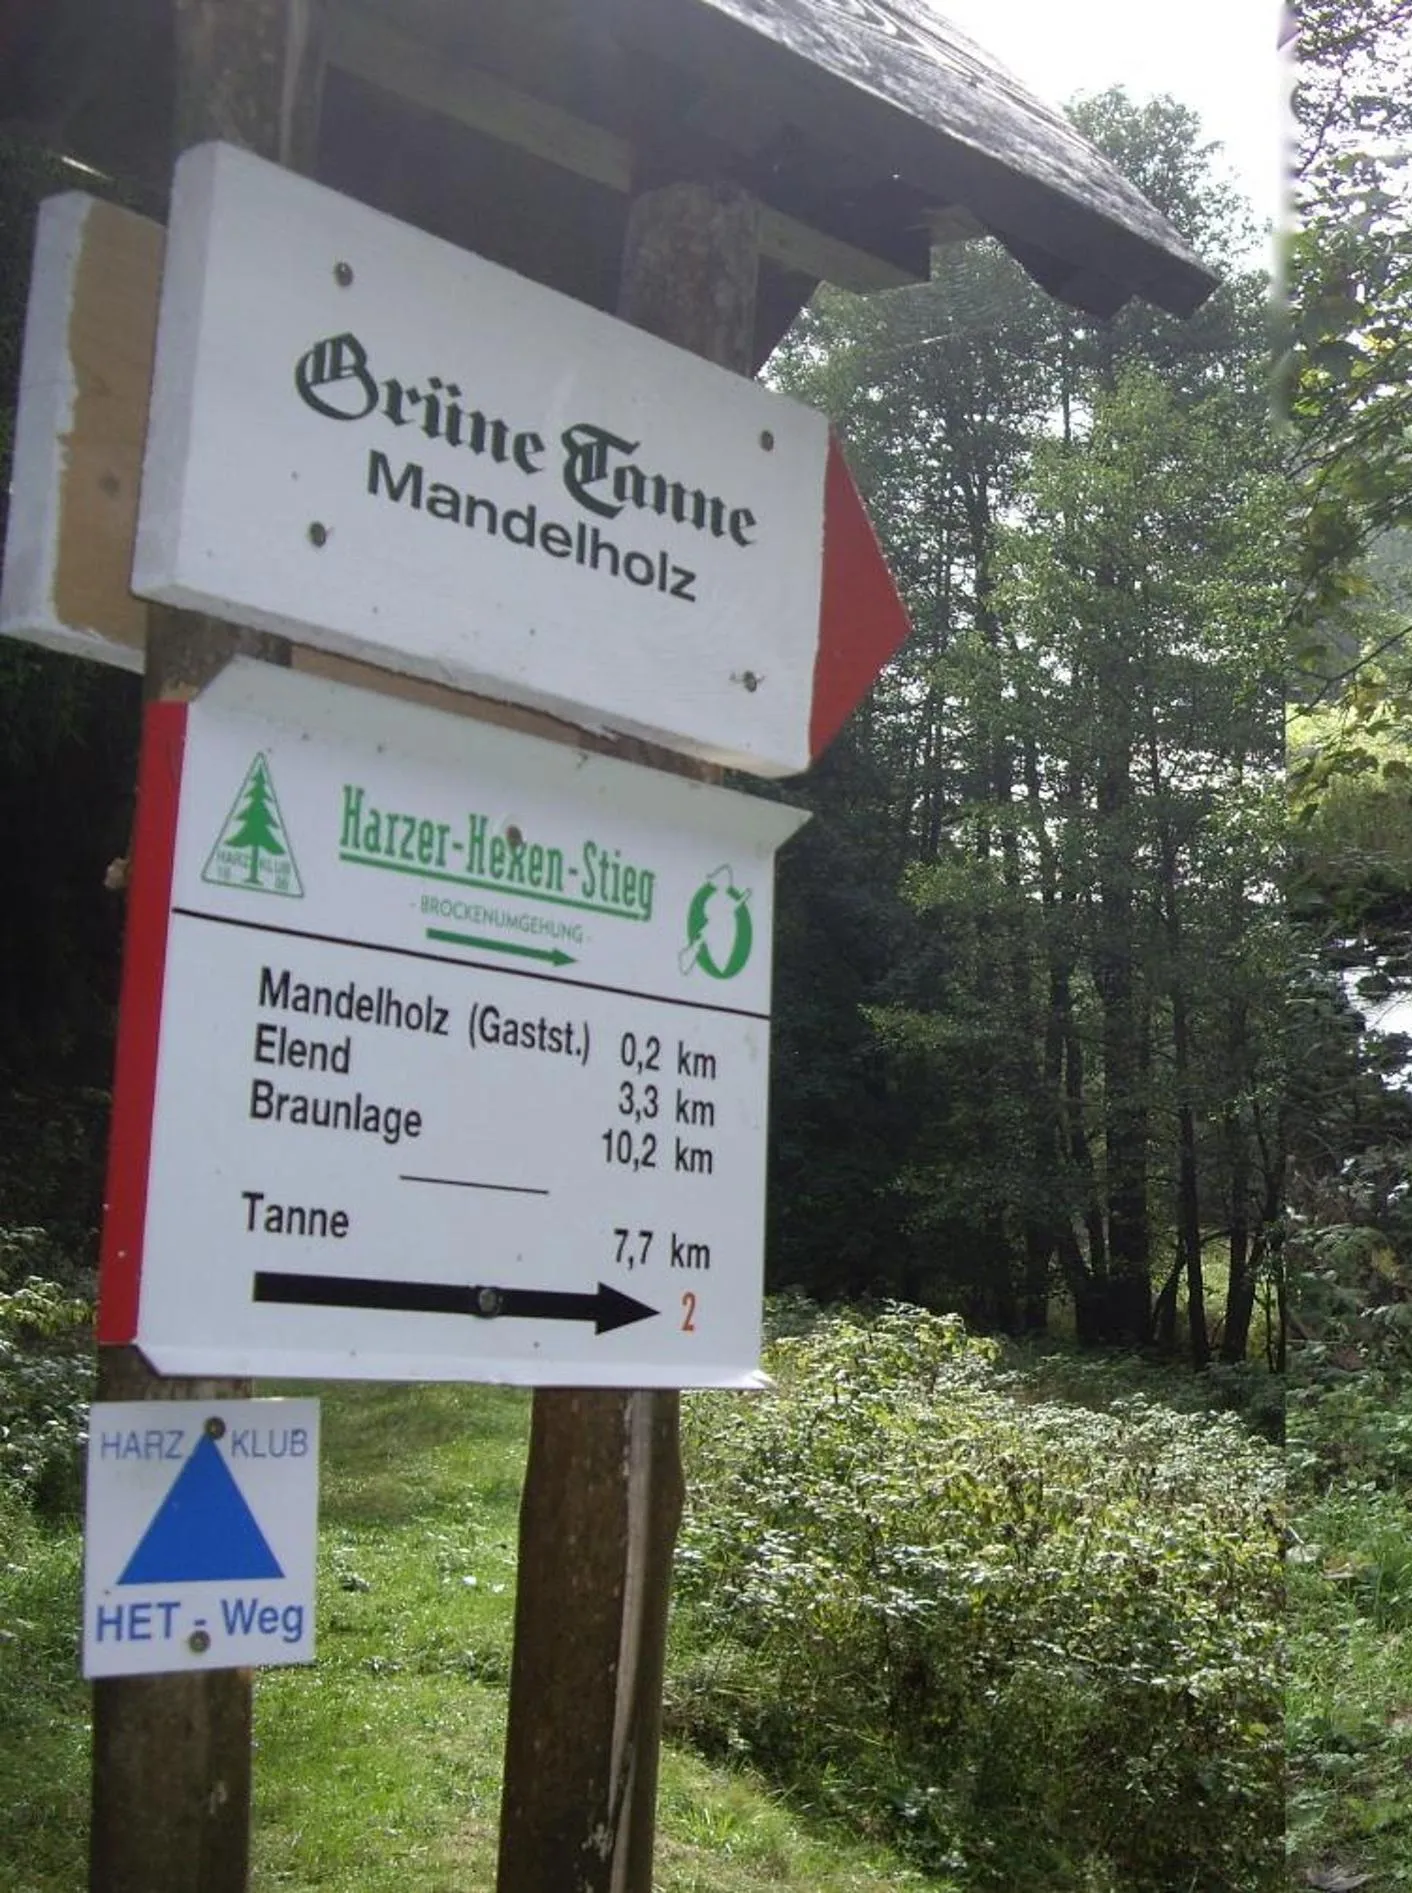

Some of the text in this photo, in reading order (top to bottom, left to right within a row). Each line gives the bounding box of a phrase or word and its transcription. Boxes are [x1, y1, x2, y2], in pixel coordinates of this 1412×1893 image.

[295, 332, 757, 548] Grüne Tanne
[367, 449, 697, 603] Mandelholz
[420, 895, 583, 943] BROCKENUMGEHUNG
[258, 966, 717, 1080] Mandelholz (Gastst.) 0,2 km
[254, 1023, 716, 1127] Elend 3,3 km
[249, 1078, 714, 1175] Braunlage 10,2 km
[242, 1191, 711, 1270] Tanne 7,7 km
[681, 1292, 696, 1332] 2
[100, 1428, 309, 1460] HARZ KLUB
[96, 1601, 181, 1642] HET
[221, 1598, 304, 1643] Weg
